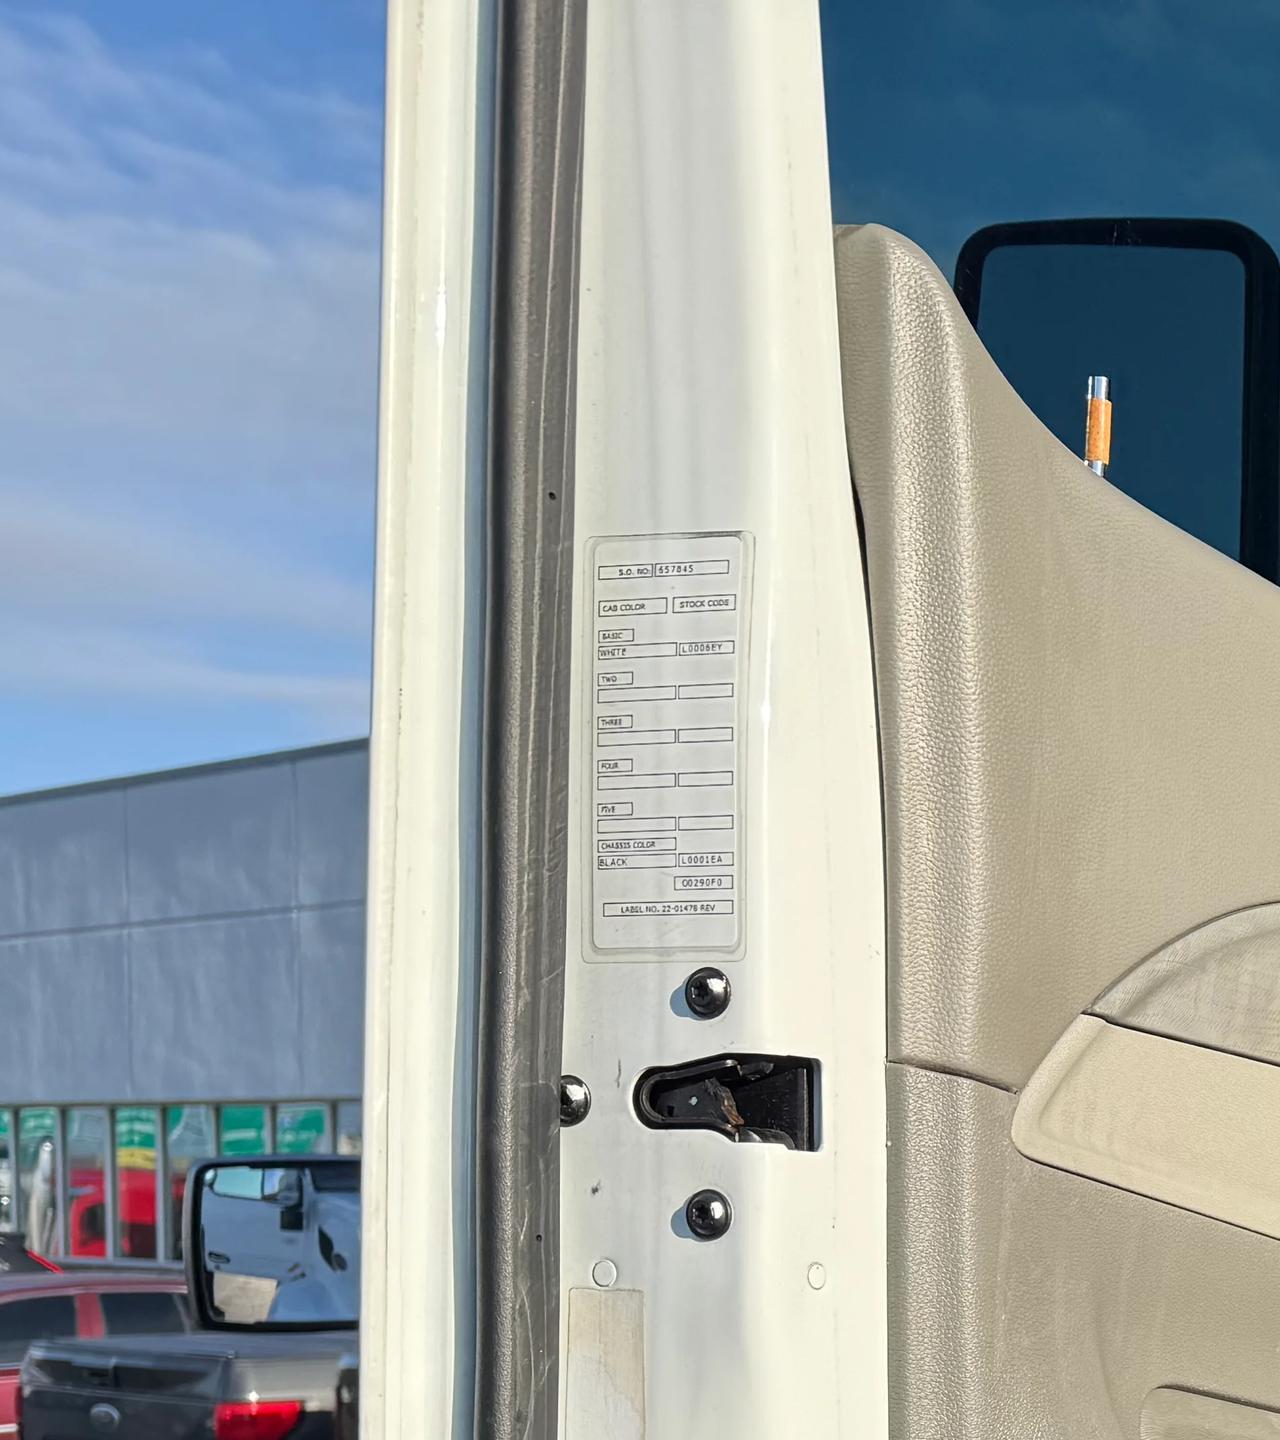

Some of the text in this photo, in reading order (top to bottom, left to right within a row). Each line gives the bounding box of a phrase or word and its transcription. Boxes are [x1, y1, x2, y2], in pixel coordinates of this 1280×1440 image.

[659, 565, 693, 574] 657845
[620, 603, 645, 611] COLOR
[680, 600, 705, 608] STOCK
[600, 648, 626, 656] WHITE
[601, 762, 619, 770] FOUR
[599, 858, 628, 867] BLACK
